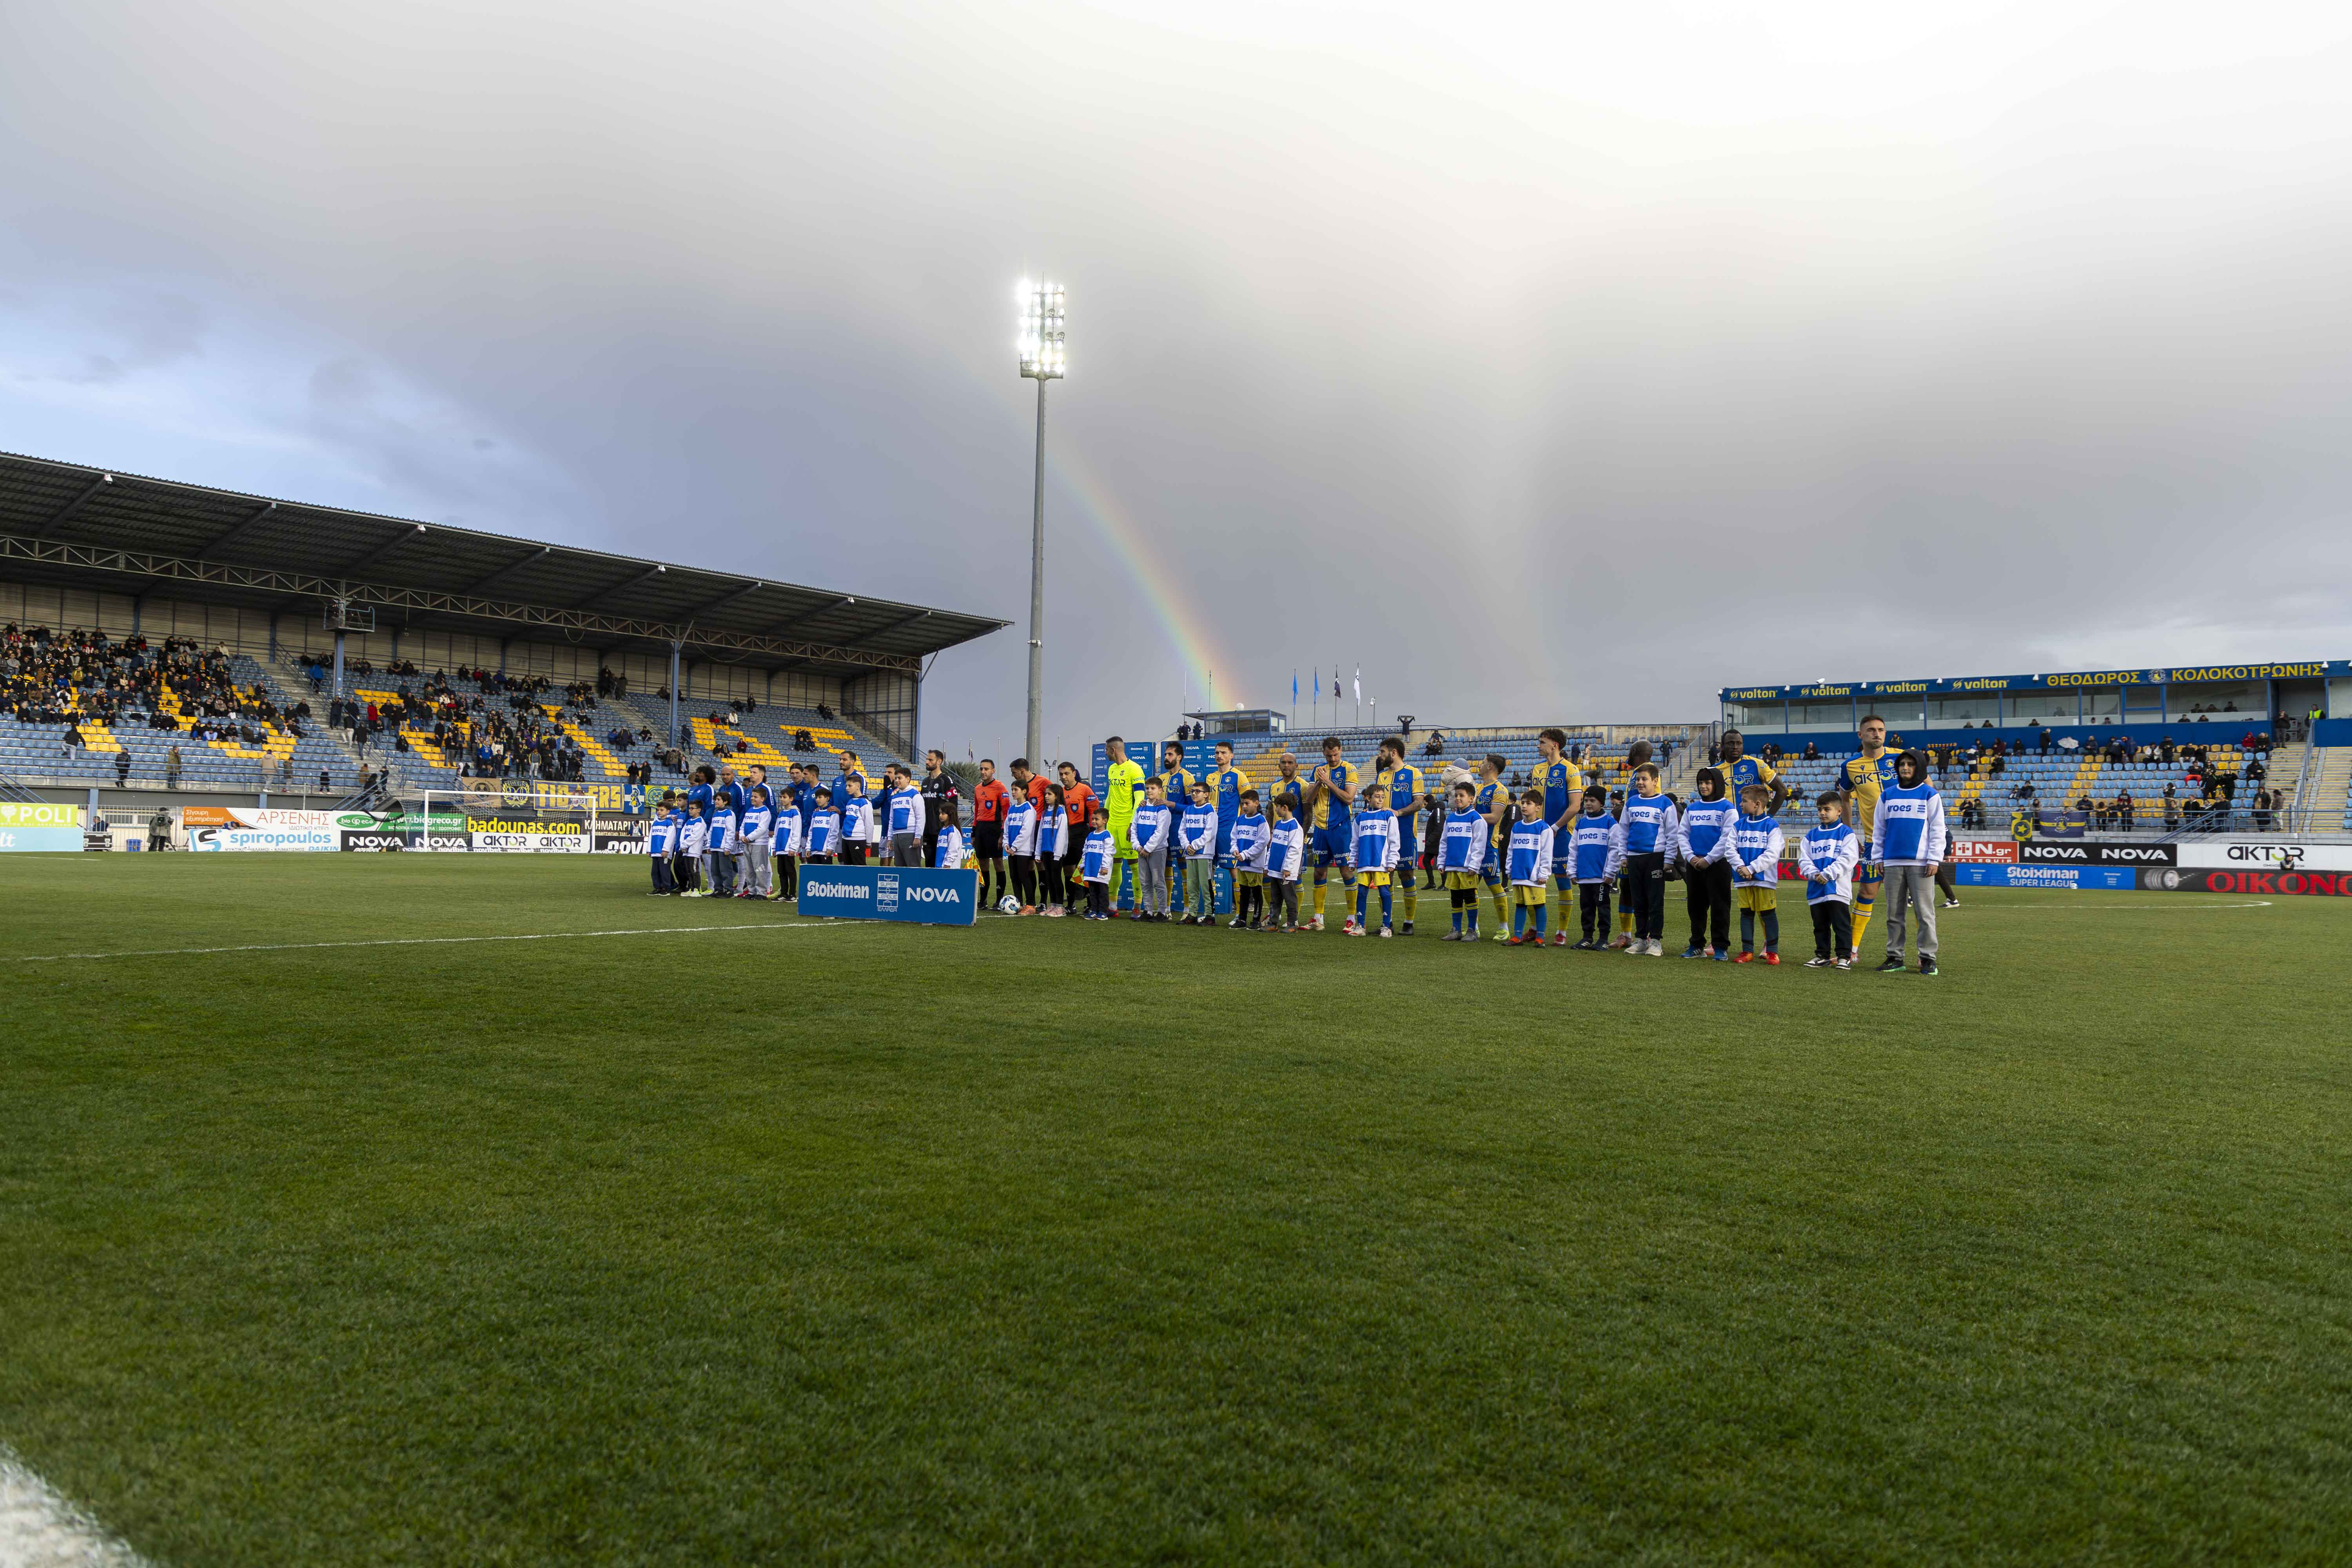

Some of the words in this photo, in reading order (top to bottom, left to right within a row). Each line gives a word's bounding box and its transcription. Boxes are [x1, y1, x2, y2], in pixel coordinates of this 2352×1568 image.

[2047, 671, 2141, 686] ΘΕΟΔΩΡΟΣ
[2172, 664, 2323, 681] ΚΟΛΟΚΟΤΡΩΝΗΣ
[1886, 682, 1927, 693] volton
[1964, 678, 2007, 690] volton
[1739, 689, 1776, 699] volton
[1811, 686, 1850, 696] volton
[1724, 774, 1754, 786] KTOR
[1161, 784, 1180, 793] KTOR
[1210, 784, 1233, 793] KTOR
[1383, 783, 1409, 792] KTOR
[20, 807, 71, 823] POLI
[256, 811, 330, 825] ΑΡΣΕΝΗΣ
[467, 816, 580, 835] badounas.com
[584, 820, 631, 831] ΚΛΗΜΑΤΑΡΙ
[0, 832, 16, 847] lt
[230, 831, 331, 846] spiropoulos
[349, 837, 404, 846] NOVA
[415, 837, 467, 847] NOVA
[1811, 845, 1831, 854] iroes
[2024, 847, 2088, 858] NOVA
[2102, 848, 2169, 860] NOVA
[2007, 866, 2079, 879] Stoiximan
[807, 880, 869, 899] Stoiximan
[906, 887, 960, 903] NOVA
